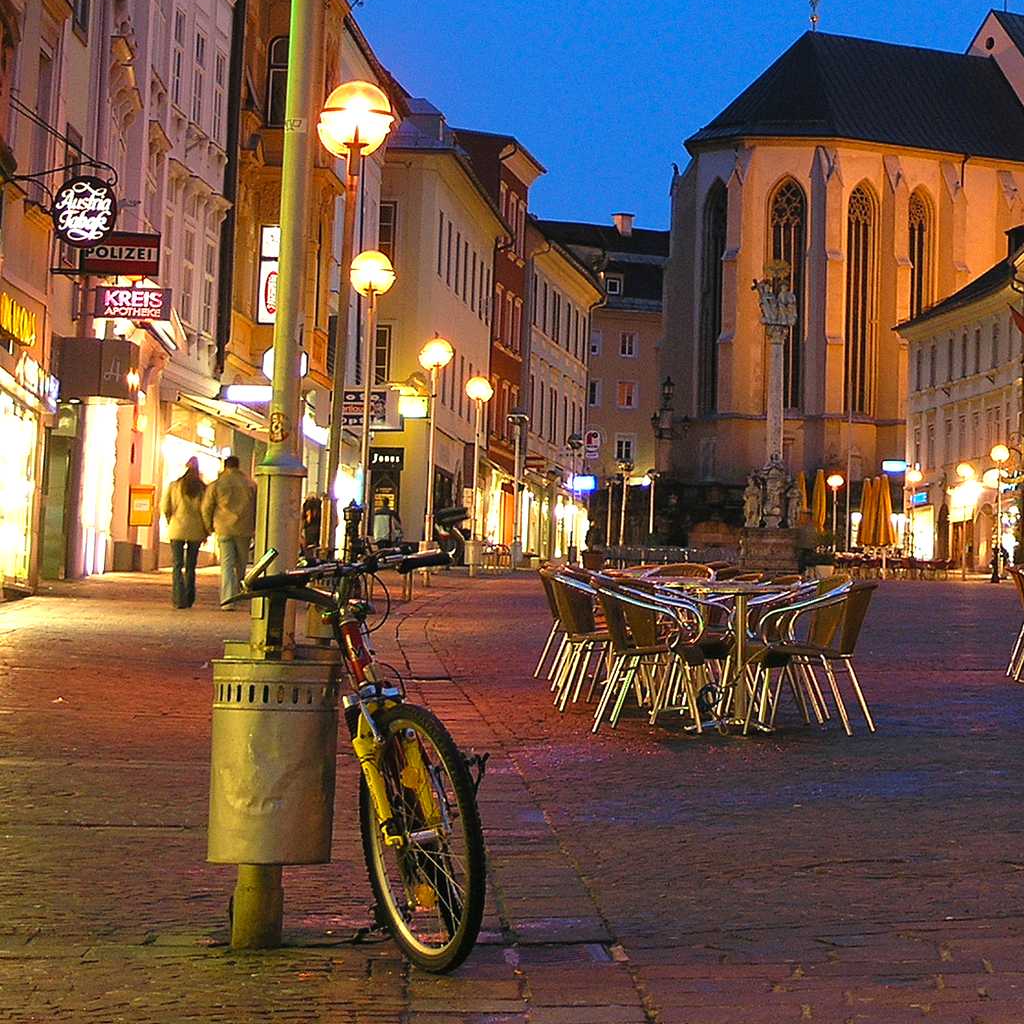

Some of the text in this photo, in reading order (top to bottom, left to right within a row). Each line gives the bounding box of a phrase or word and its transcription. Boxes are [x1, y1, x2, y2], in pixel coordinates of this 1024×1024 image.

[55, 182, 112, 212] Austria
[58, 209, 112, 239] Tabak
[85, 247, 153, 260] POLIZEI
[104, 289, 163, 308] KREIS
[104, 306, 161, 318] APOTHEKE
